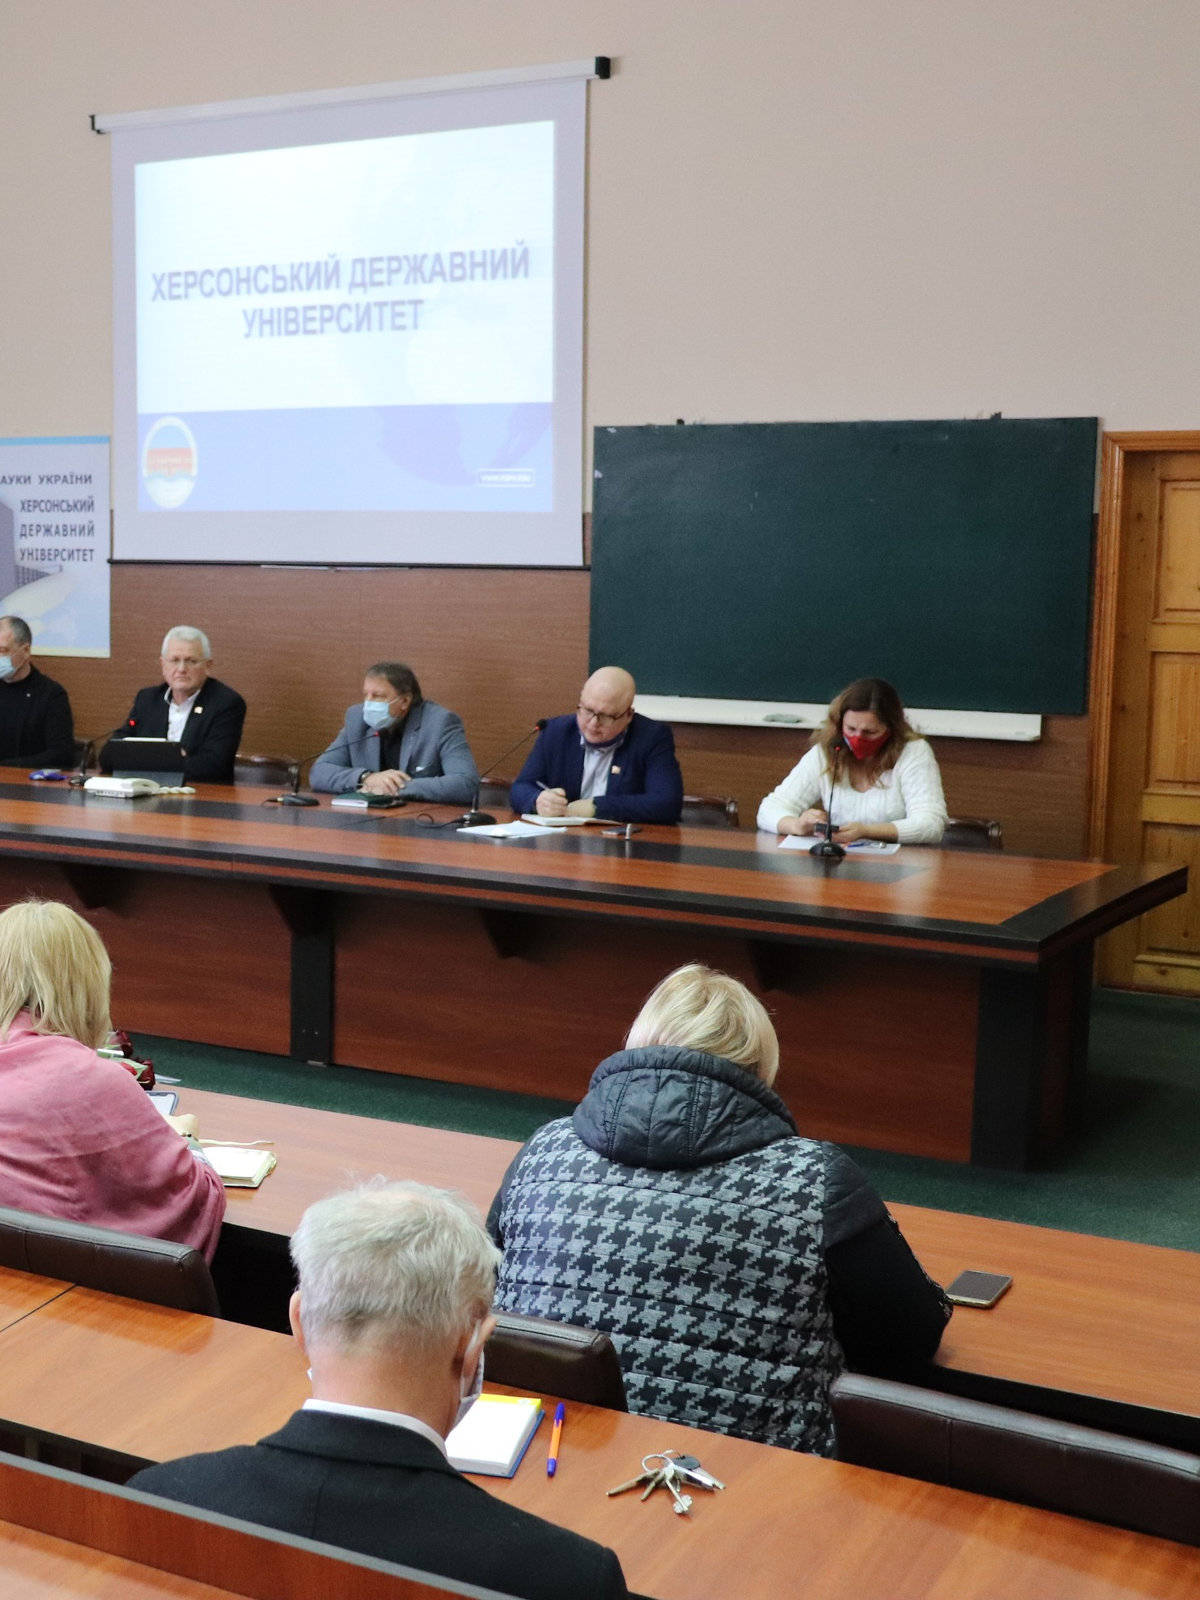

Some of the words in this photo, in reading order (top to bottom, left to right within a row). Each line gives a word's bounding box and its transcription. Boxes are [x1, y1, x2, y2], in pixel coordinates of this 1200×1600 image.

[151, 254, 340, 302] ХЕРСОНСЬКИЙ
[349, 240, 531, 292] ДЕРЖАВНИЙ
[242, 299, 424, 338] УНІВЕРСИТЕТ
[38, 472, 93, 485] УКРАЇНИ
[20, 496, 95, 513] ХЕРСОНСЬКИЙ
[20, 520, 95, 538] ДЕРЖАВНИЙ
[20, 548, 95, 562] УНІВЕРСИТЕТ
